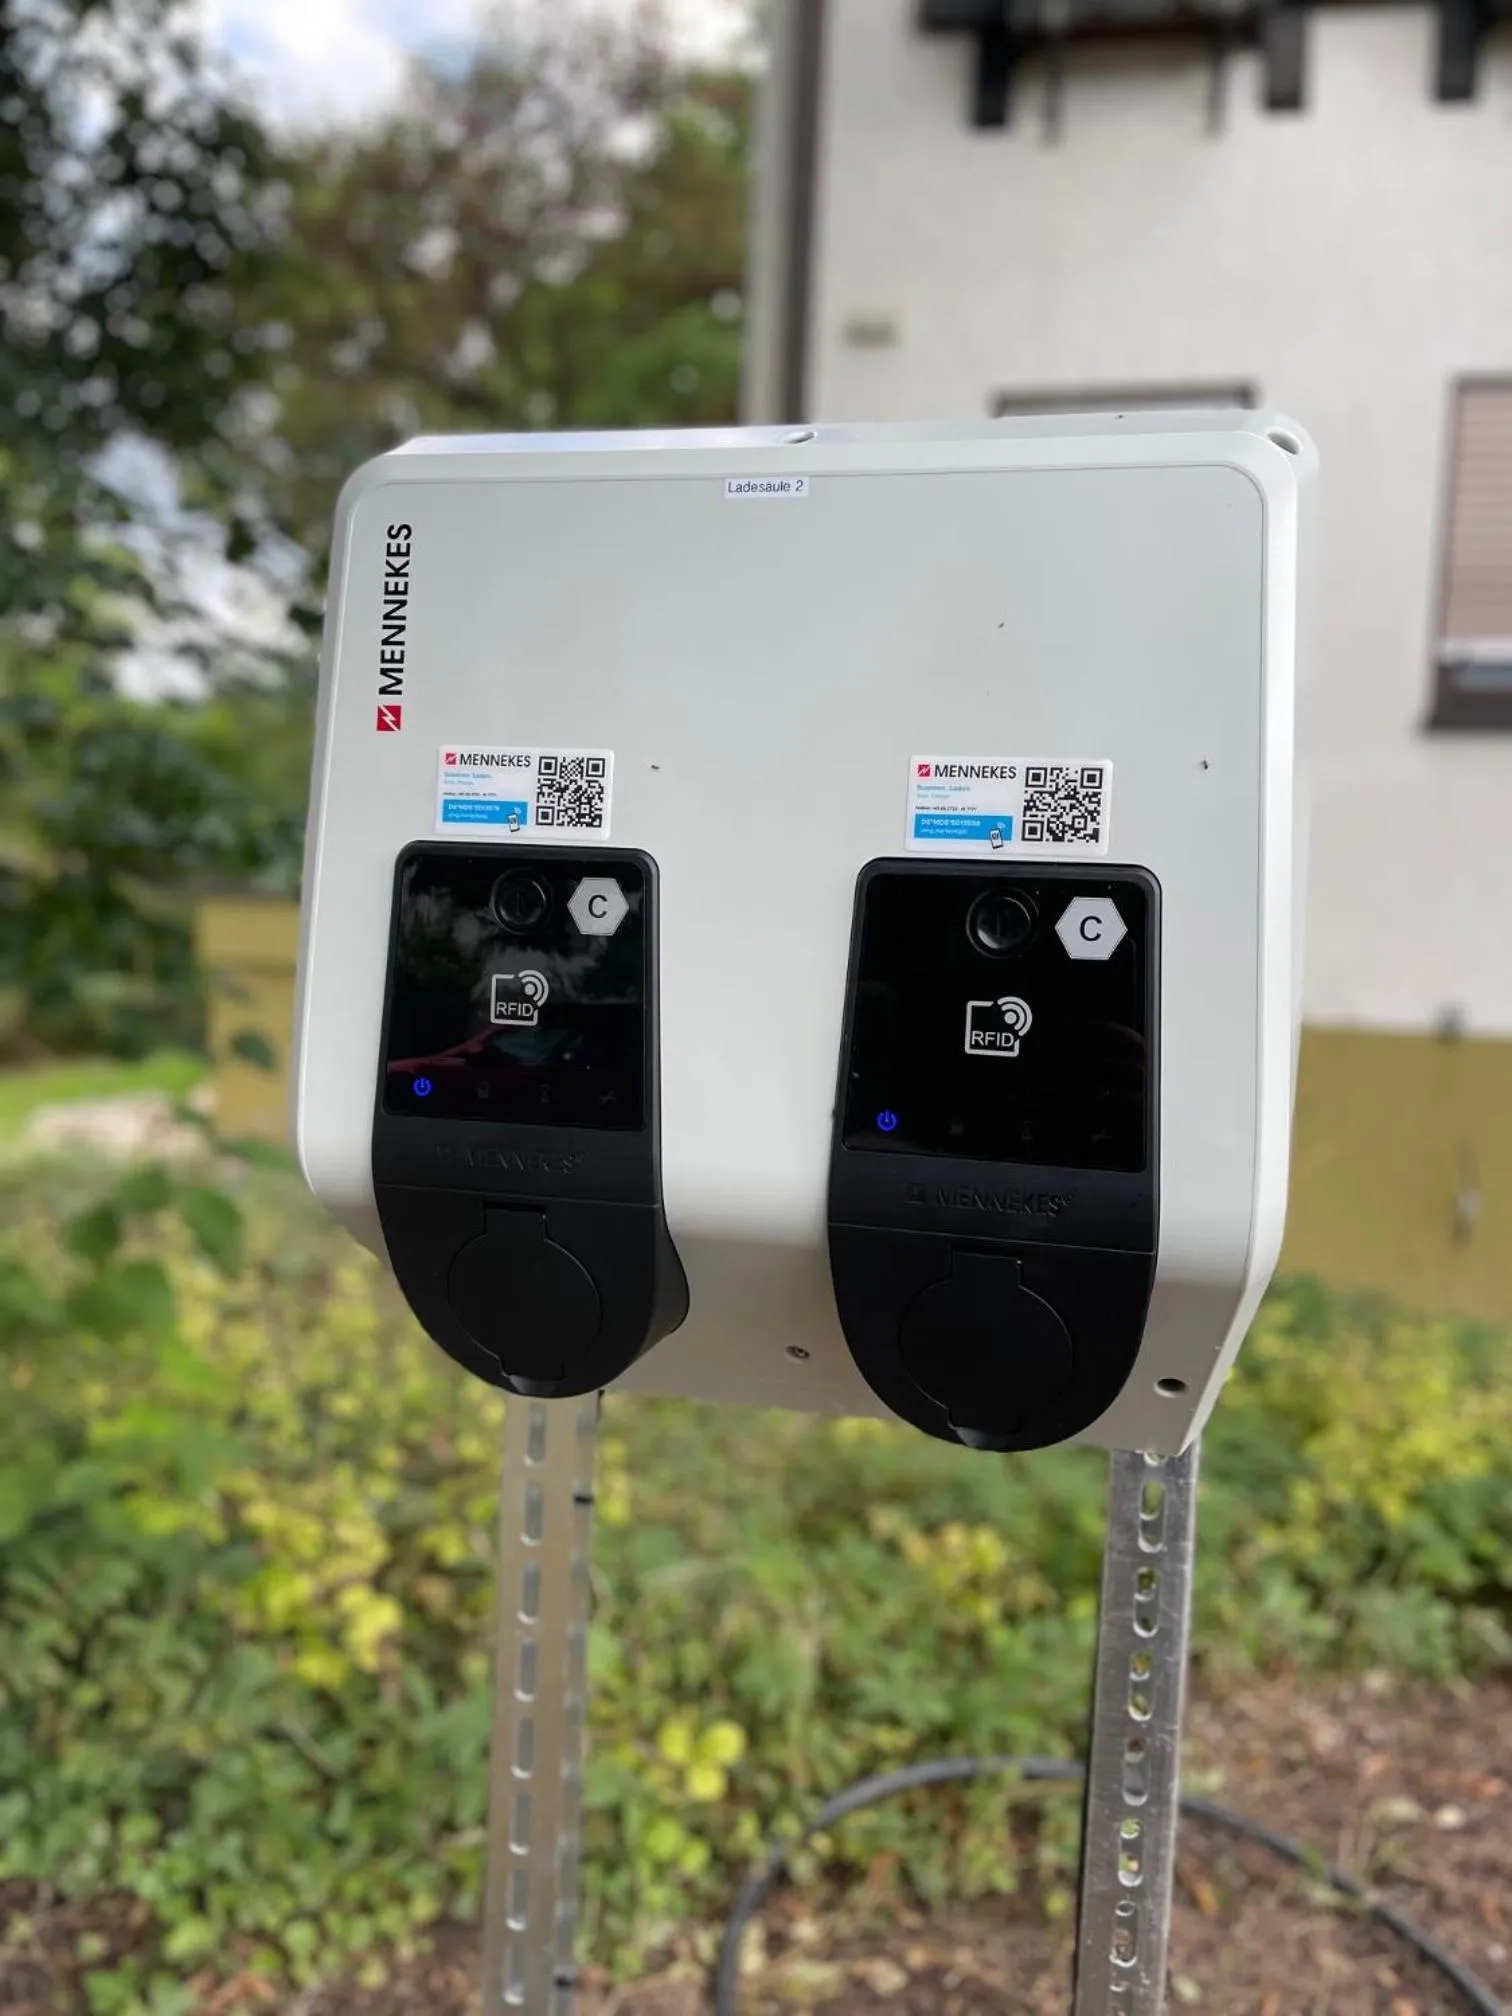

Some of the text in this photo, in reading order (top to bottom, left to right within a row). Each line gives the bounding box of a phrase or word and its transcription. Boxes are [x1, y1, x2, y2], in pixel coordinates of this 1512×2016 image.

[795, 480, 804, 492] 2
[379, 523, 412, 695] MENNEKES
[460, 753, 532, 768] MENNEKES
[934, 764, 1017, 779] MENNEKES
[588, 894, 608, 919] C
[1079, 915, 1103, 942] C
[496, 1002, 534, 1017] RFID
[971, 1031, 1014, 1047] RFID
[465, 1148, 581, 1175] MENNS
